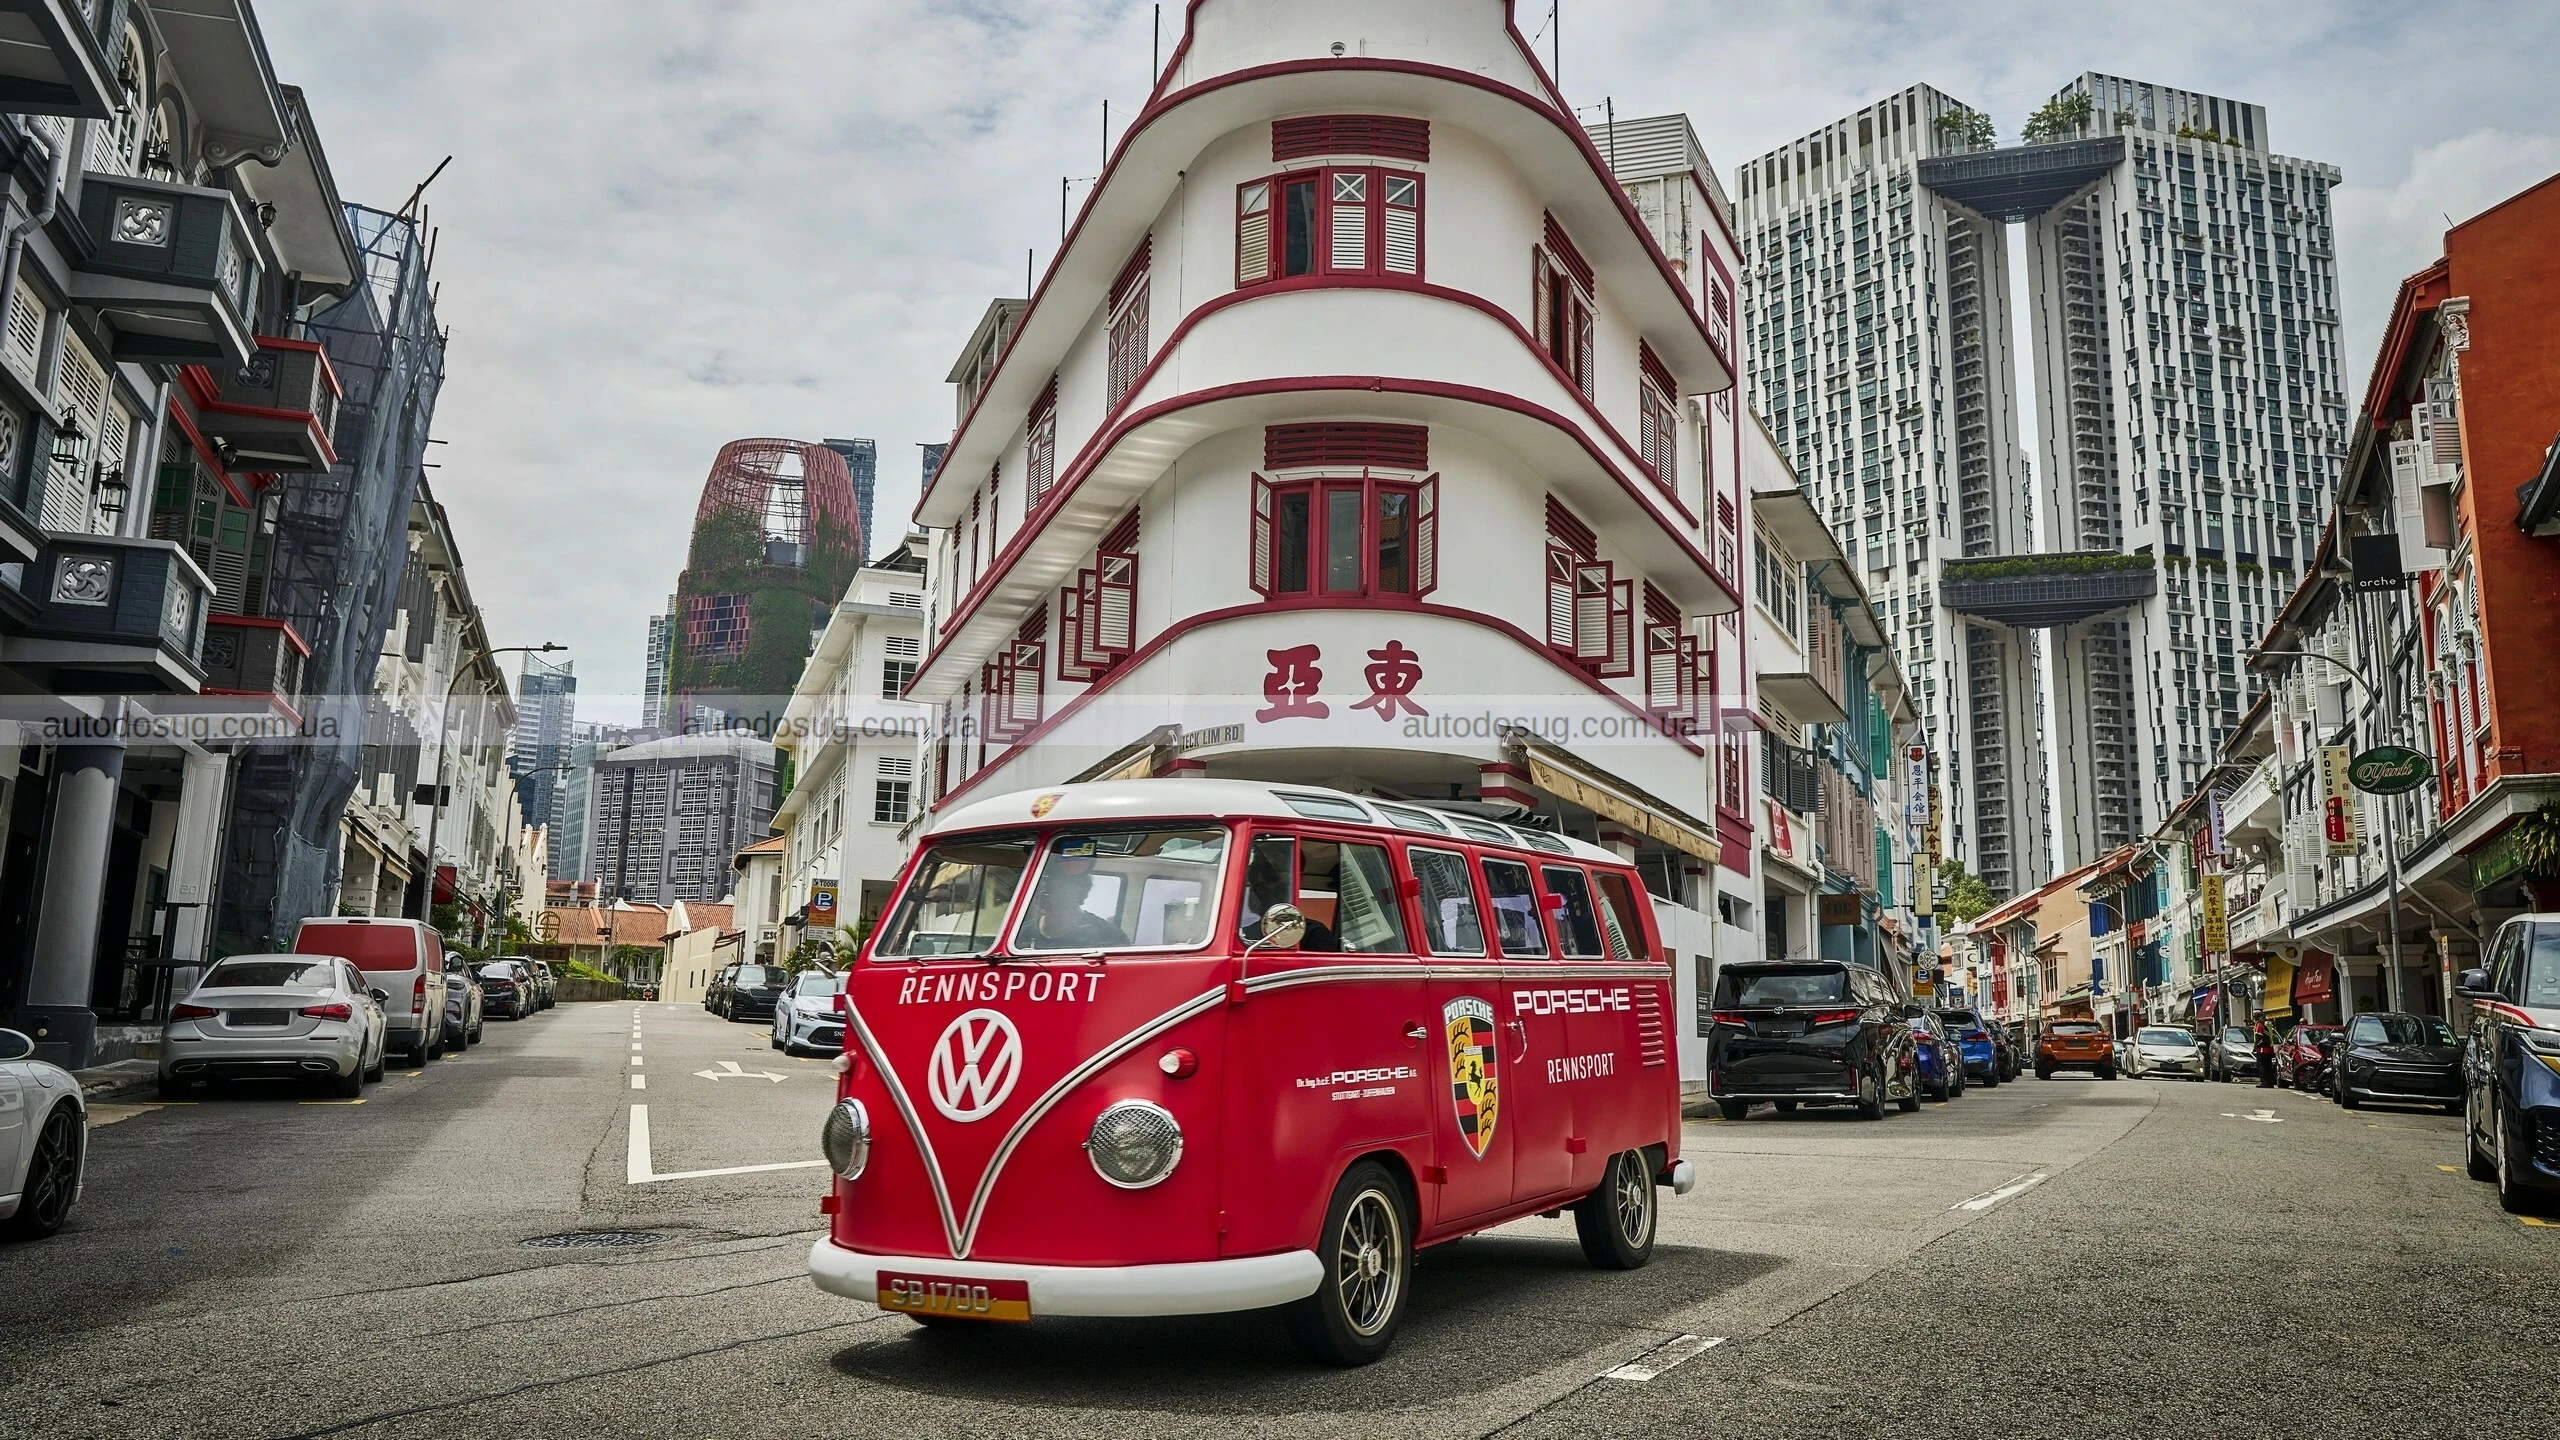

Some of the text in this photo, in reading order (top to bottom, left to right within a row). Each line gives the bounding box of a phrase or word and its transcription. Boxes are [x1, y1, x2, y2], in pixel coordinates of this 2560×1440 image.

[2360, 576, 2396, 587] arche
[1182, 725, 1239, 750] TECK LIM RD
[2323, 750, 2333, 796] FOCUS
[2404, 780, 2417, 790] NASI
[1912, 765, 1925, 814] 恩平会馆
[1772, 800, 1782, 818] FOR
[2328, 800, 2337, 840] MUSIC
[518, 945, 569, 958] MEET
[898, 970, 1106, 1005] RENNSPORT
[1444, 998, 1493, 1025] PORSCHE
[1512, 988, 1631, 1016] PORSCHE
[1331, 1066, 1408, 1085] PORSCHE
[1547, 1052, 1615, 1084] RENNSPORT
